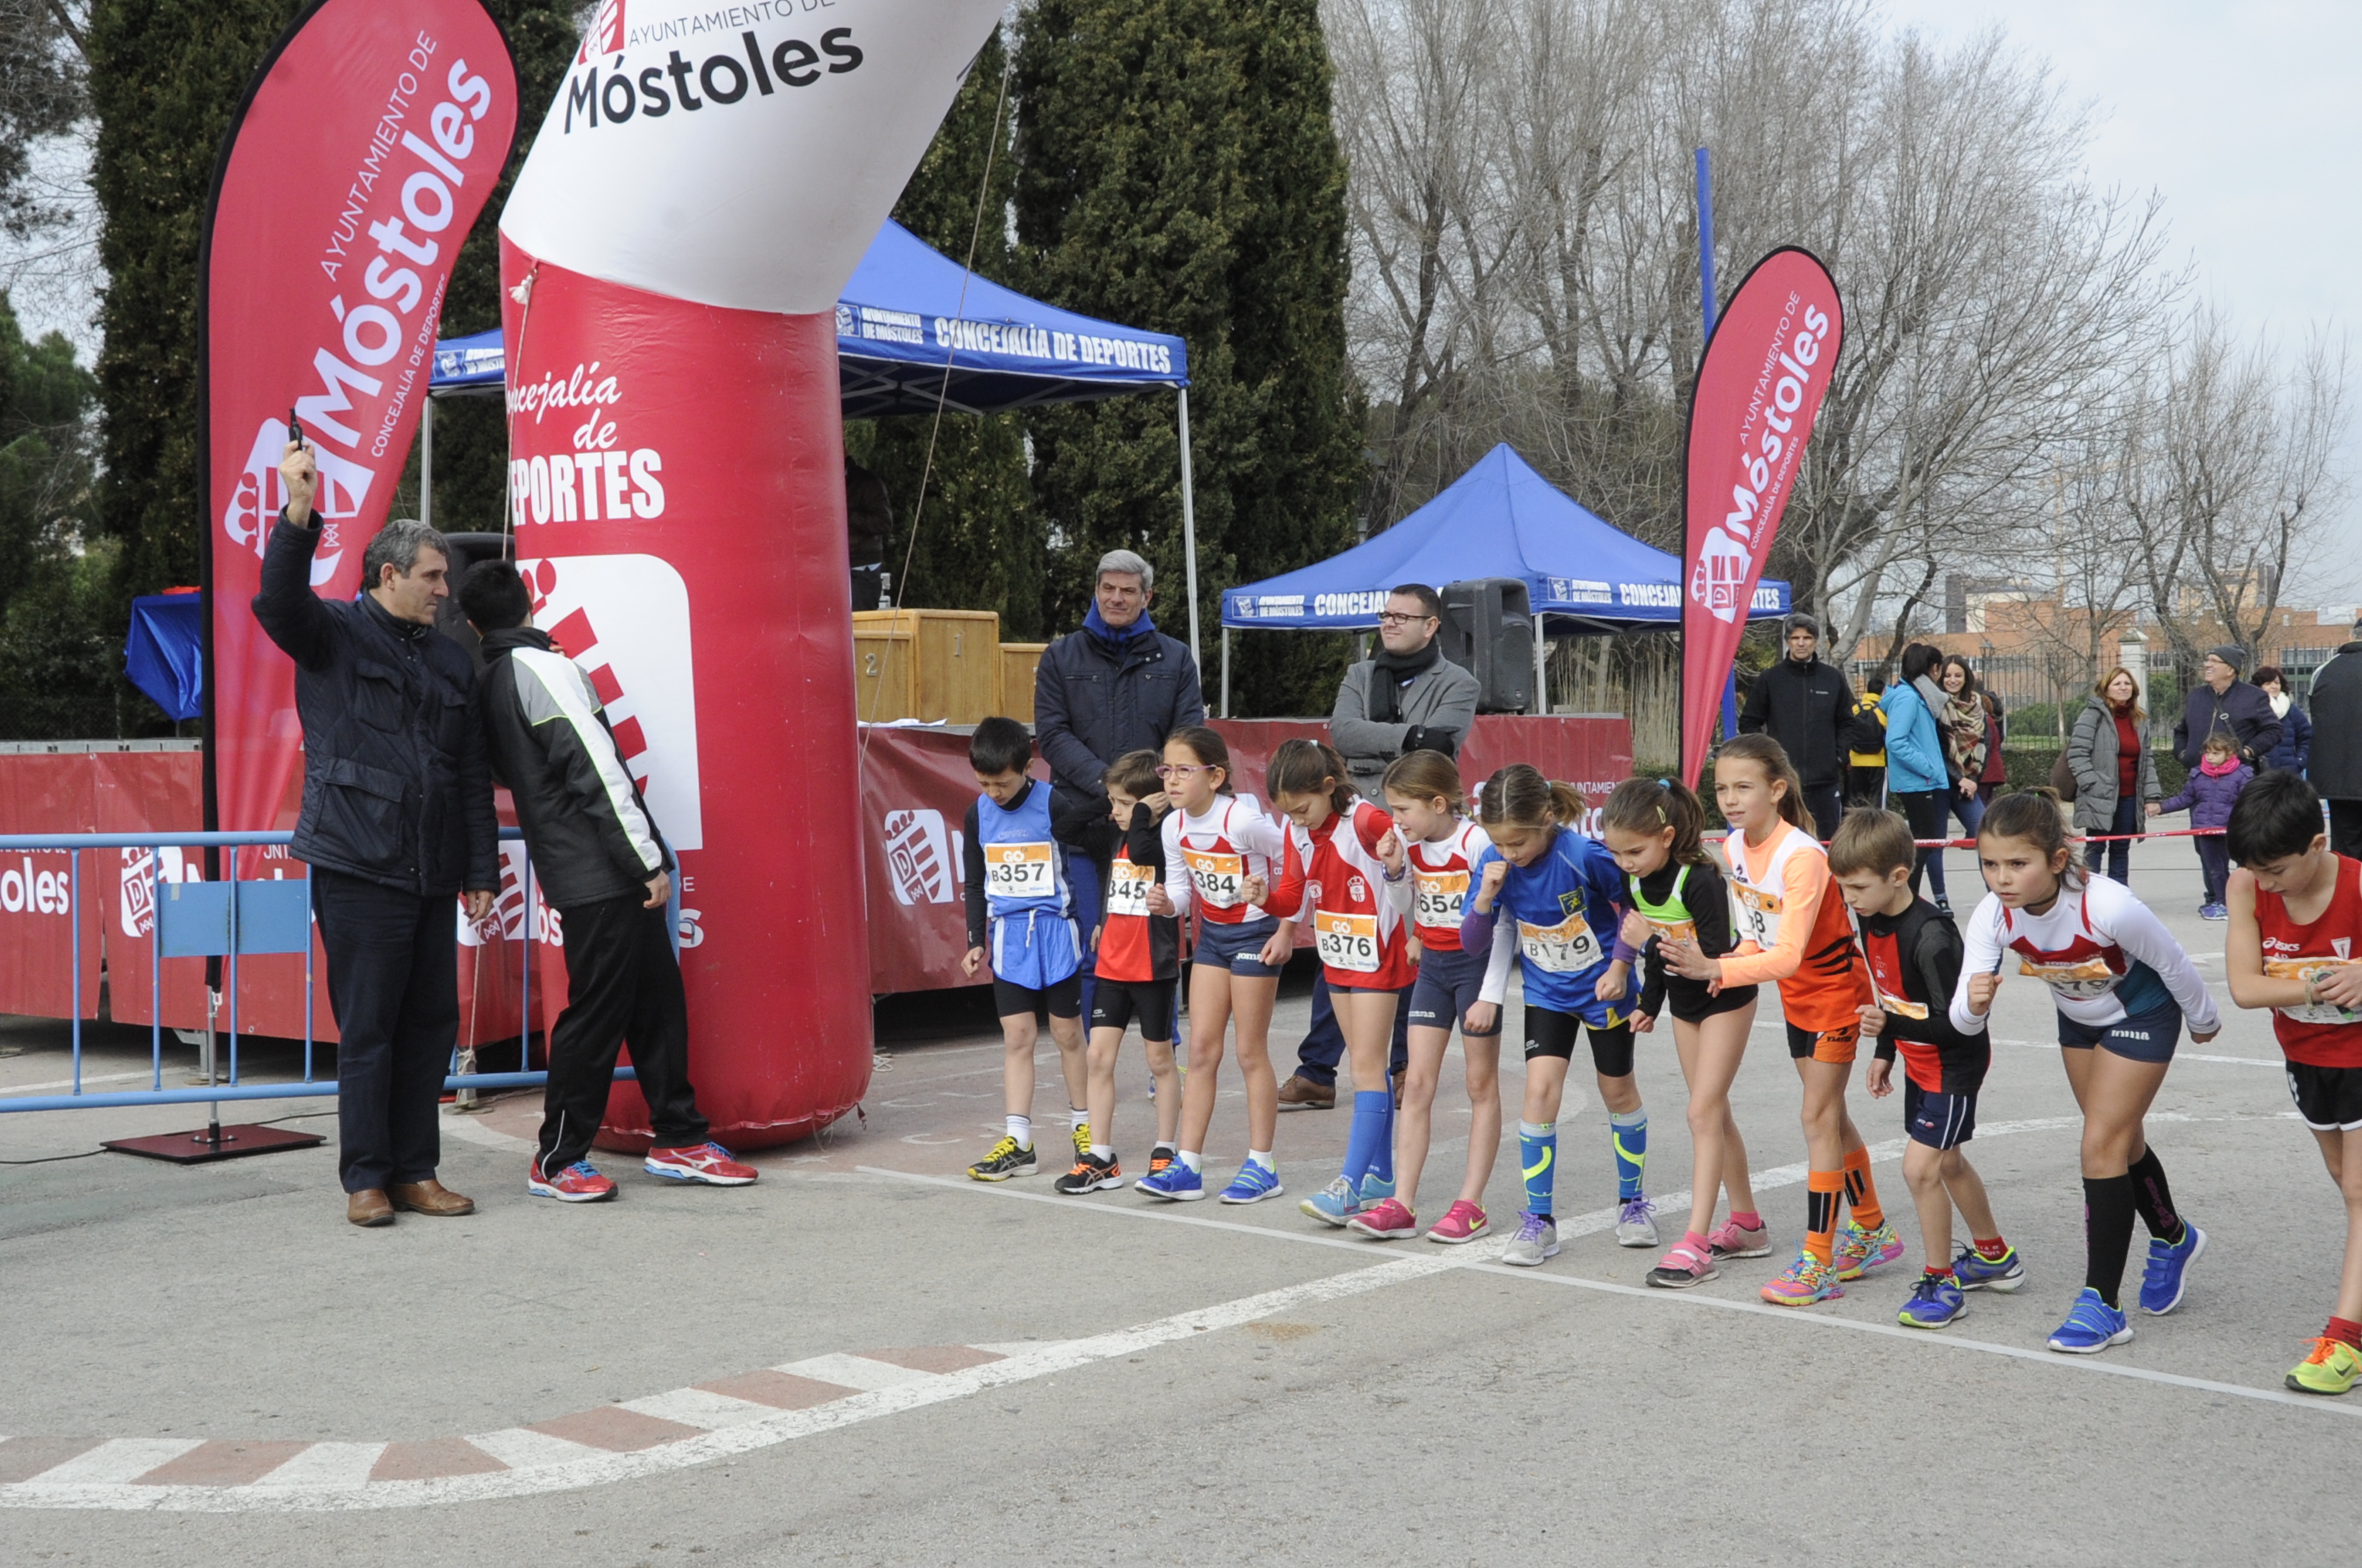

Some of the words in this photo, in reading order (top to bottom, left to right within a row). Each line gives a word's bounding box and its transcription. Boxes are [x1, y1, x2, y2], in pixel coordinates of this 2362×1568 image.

[629, 0, 793, 47] AYUNTAMIENTO
[564, 27, 864, 135] Móstoles
[321, 72, 417, 282] AYUNTAMIENTO
[408, 30, 437, 71] DE
[294, 58, 491, 449] Móstoles
[861, 306, 921, 328] AYUNTAMIENTO
[863, 322, 876, 339] DE
[876, 322, 924, 344] MÓSTOLES
[934, 316, 1051, 359] CONCEJALÍA
[1052, 331, 1078, 361] DE
[1077, 334, 1172, 374] DEPORTES
[1739, 316, 1790, 445] AYUNTAMIENTO
[1785, 290, 1800, 316] DE
[371, 368, 417, 457] CONCEJALÍA
[409, 344, 425, 367] DE
[573, 407, 618, 450] de
[1725, 304, 1829, 541] Móstoles
[1750, 496, 1777, 550] CONCEJALÍA
[1772, 480, 1782, 495] DE
[1777, 436, 1799, 482] DEPORTES
[865, 652, 877, 677] 2
[954, 634, 961, 657] 1
[1003, 850, 1025, 863] GO
[1196, 858, 1216, 872] GO
[0, 857, 69, 916] oles
[1195, 871, 1236, 894] 384
[1419, 879, 1441, 893] GO
[1332, 921, 1351, 933] GO
[2262, 937, 2300, 952] asics
